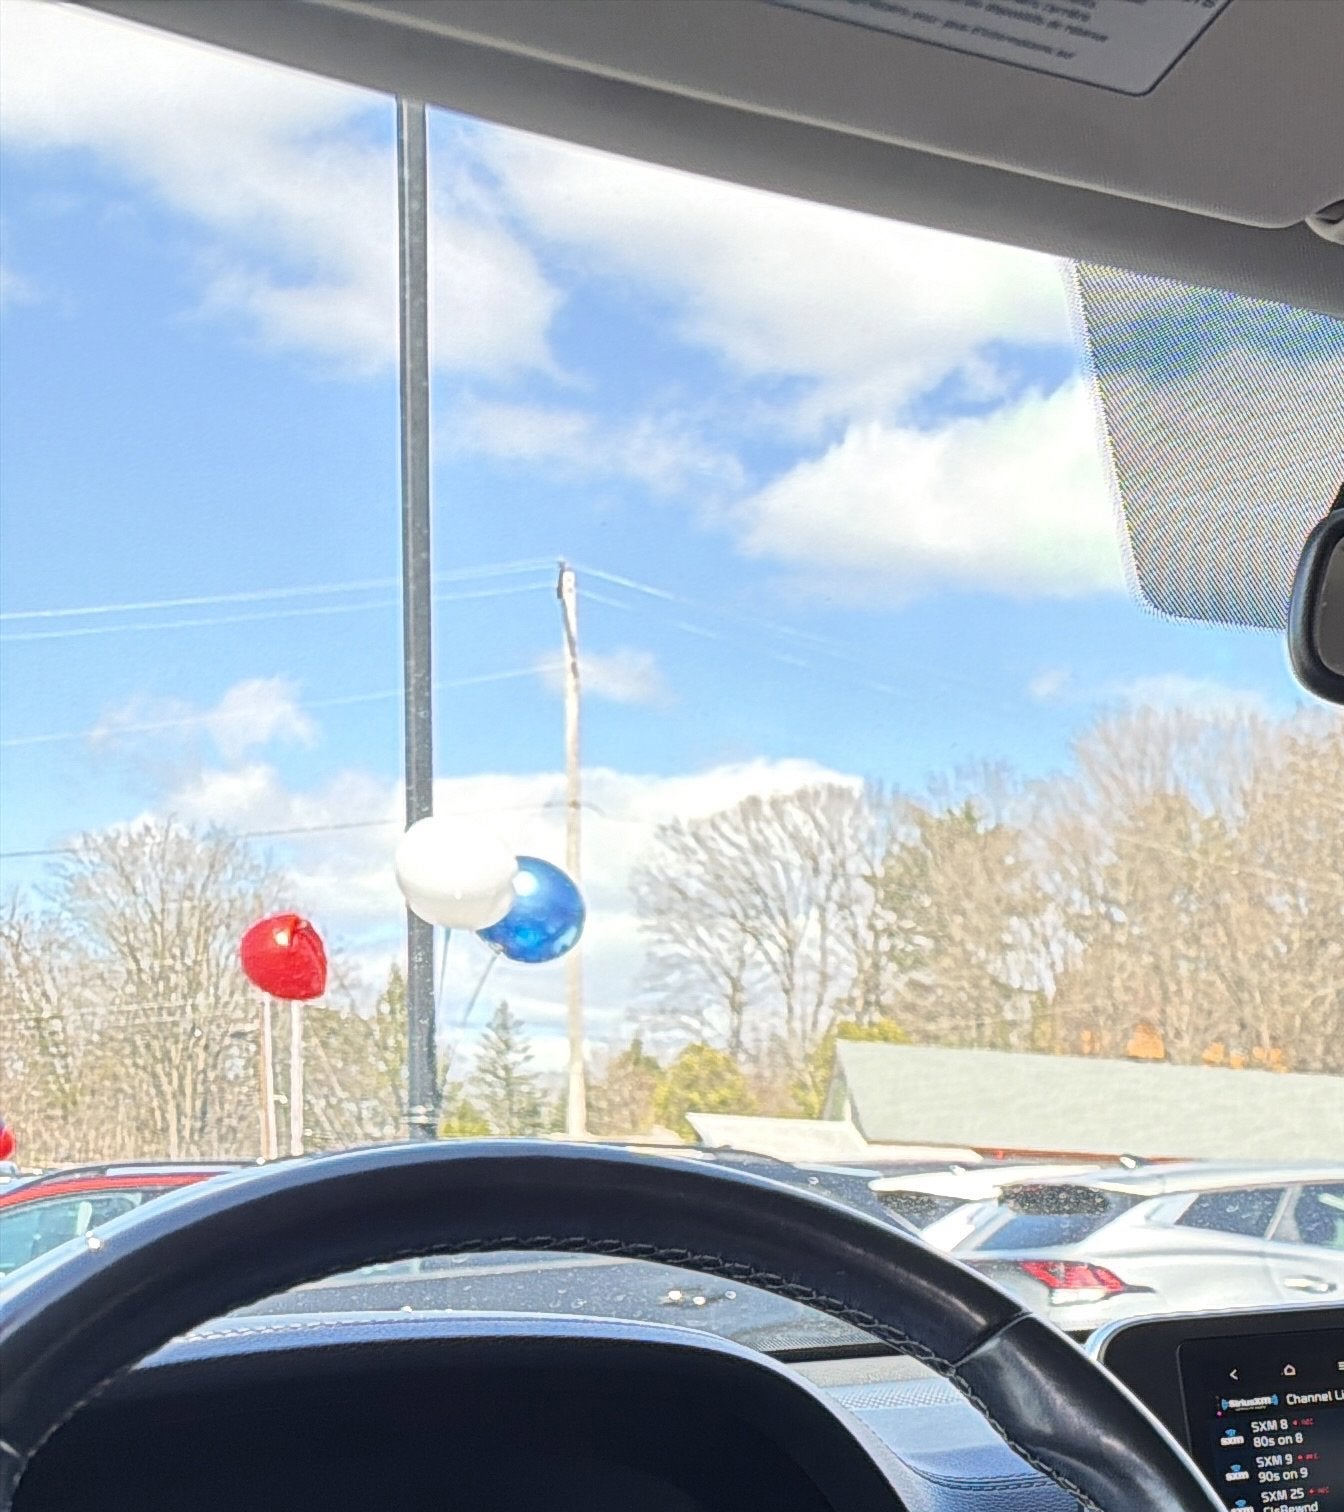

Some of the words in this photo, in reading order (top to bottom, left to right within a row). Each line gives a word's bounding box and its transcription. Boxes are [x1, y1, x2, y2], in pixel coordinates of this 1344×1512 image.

[1286, 1391, 1333, 1405] Channel
[1251, 1420, 1277, 1433] SXM
[1279, 1418, 1289, 1430] 8
[1253, 1436, 1276, 1448] 80s
[1278, 1436, 1293, 1446] on
[1295, 1432, 1303, 1444] 8
[1256, 1455, 1283, 1468] SXM
[1285, 1453, 1293, 1465] 9
[1258, 1471, 1281, 1483] 90s
[1282, 1471, 1298, 1481] on
[1300, 1467, 1308, 1479] 9
[1261, 1491, 1288, 1503] SXM
[1290, 1488, 1305, 1499] 25
